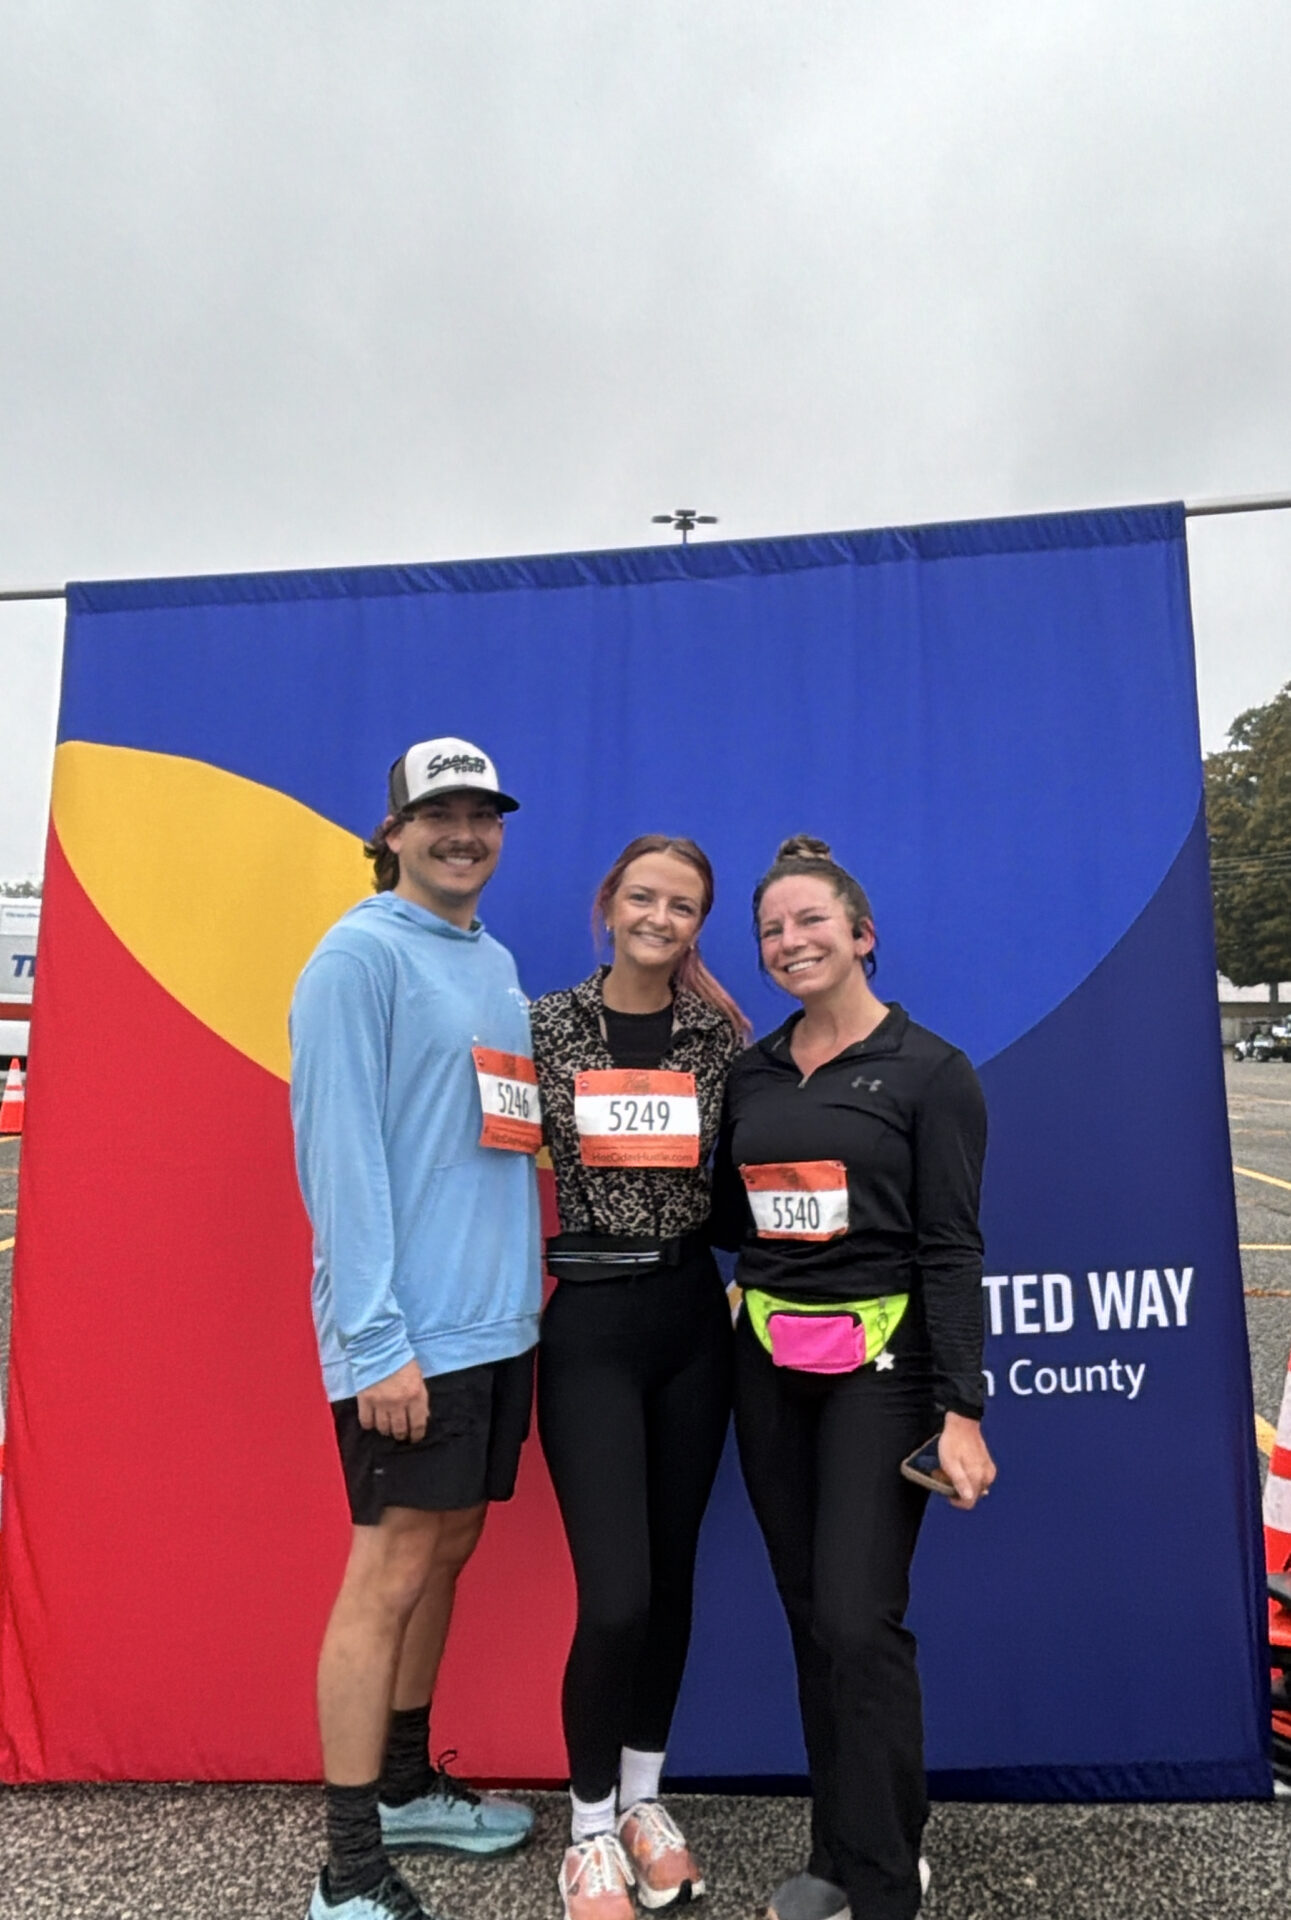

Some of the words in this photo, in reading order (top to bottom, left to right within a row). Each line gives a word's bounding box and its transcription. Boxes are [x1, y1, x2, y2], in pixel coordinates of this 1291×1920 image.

[497, 1082, 529, 1118] 5246
[608, 1100, 670, 1131] 5249
[773, 1196, 820, 1229] 5540
[981, 1273, 1074, 1335] TED
[1087, 1267, 1194, 1331] WAY
[1009, 1358, 1146, 1400] County
